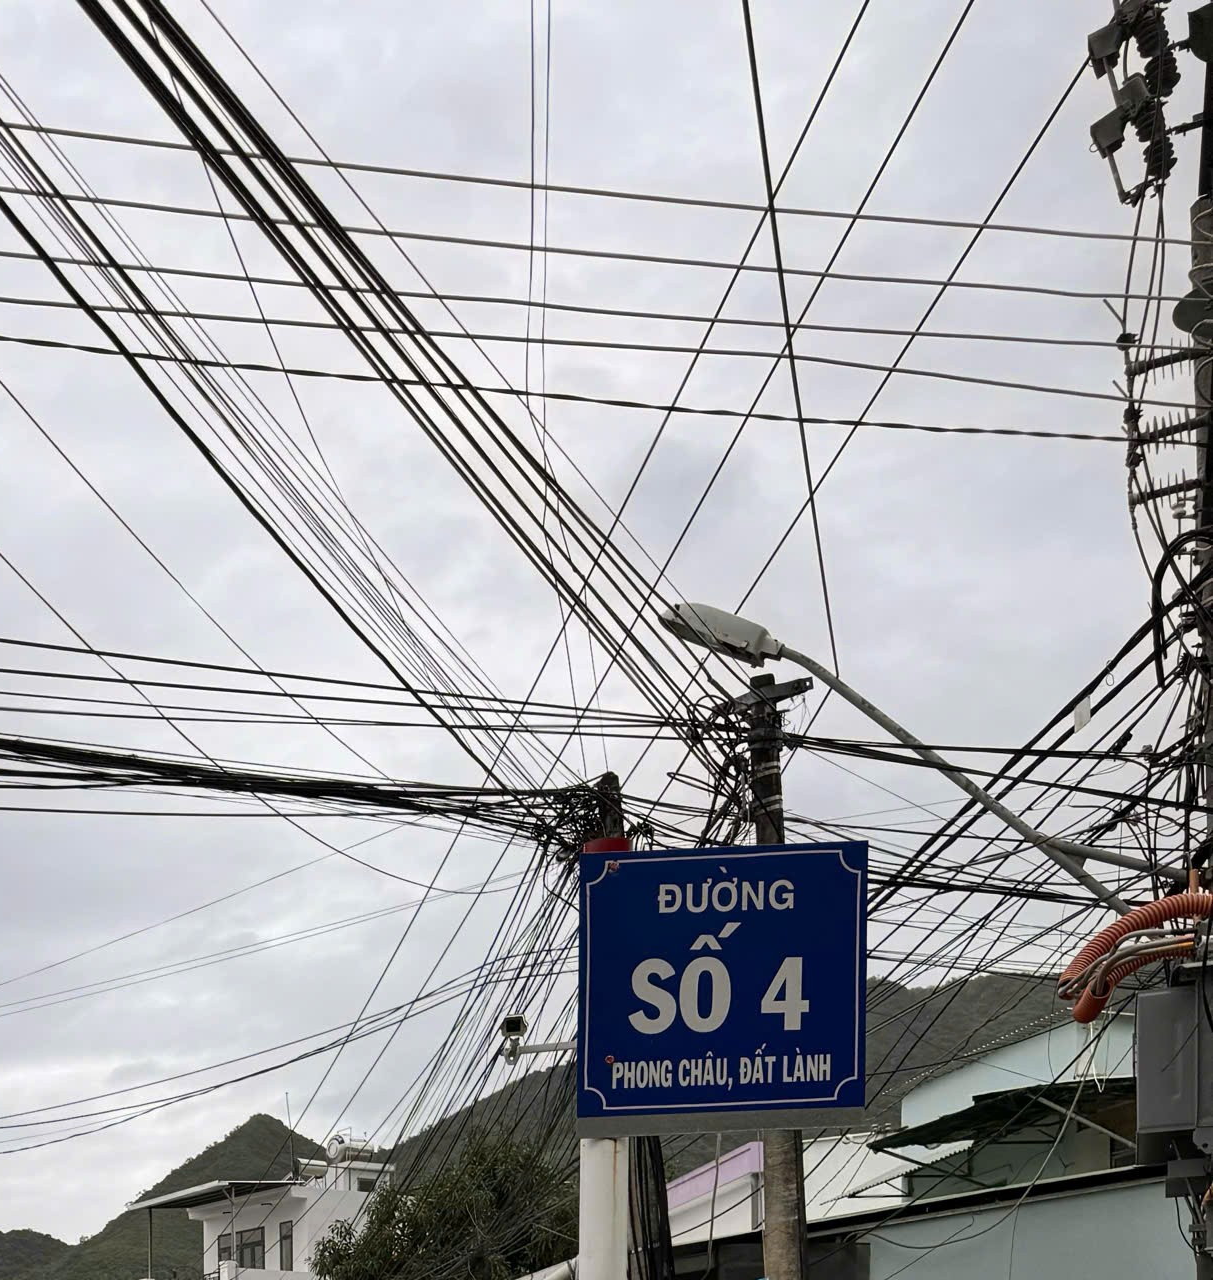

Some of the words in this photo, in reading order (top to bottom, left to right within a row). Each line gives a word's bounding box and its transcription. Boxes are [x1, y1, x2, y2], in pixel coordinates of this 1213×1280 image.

[657, 866, 795, 914] ĐƯỜNG
[628, 922, 741, 1035] SỐ
[760, 956, 810, 1031] 4
[611, 1058, 673, 1089] PHONG
[678, 1051, 733, 1091] CHÂU,
[739, 1043, 776, 1085] ĐẤT
[782, 1048, 831, 1083] LÀNH
